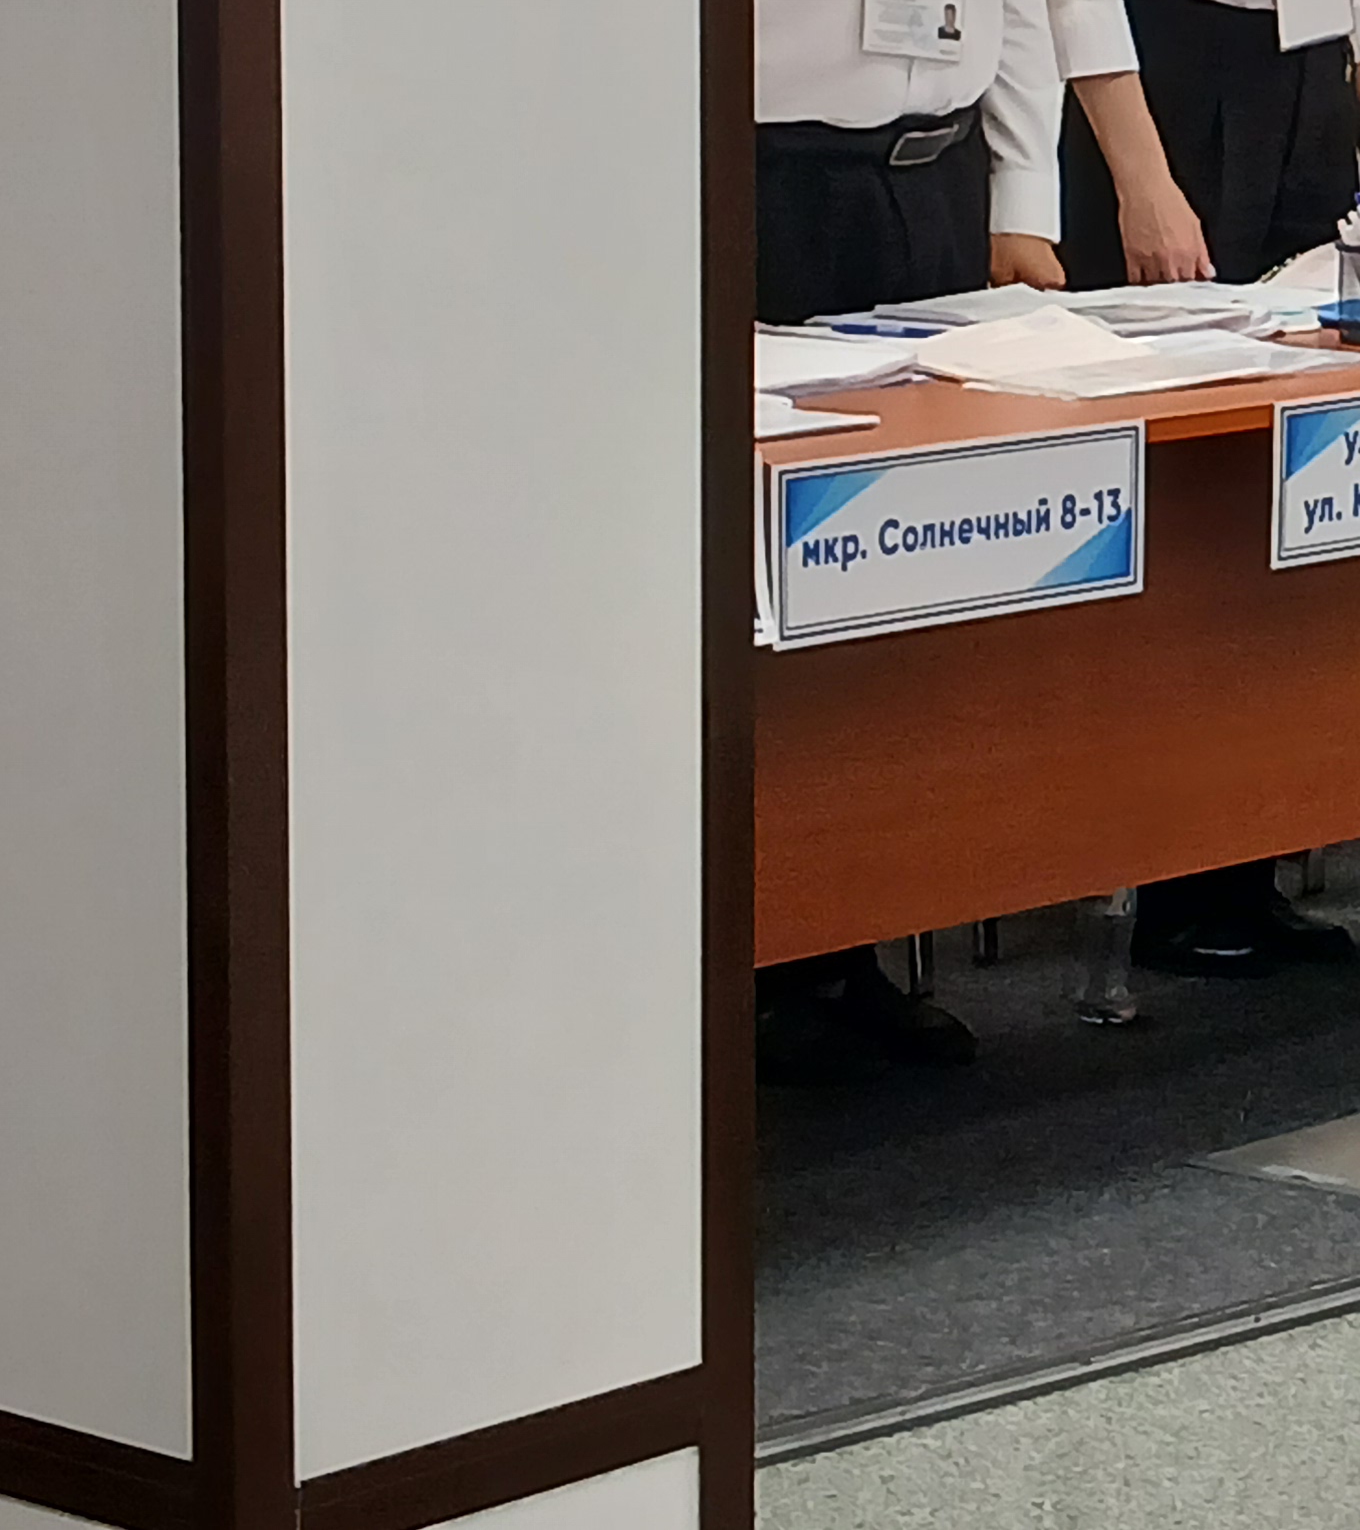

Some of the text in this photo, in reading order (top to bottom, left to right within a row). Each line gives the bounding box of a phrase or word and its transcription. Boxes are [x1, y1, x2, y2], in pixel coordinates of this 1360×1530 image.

[802, 488, 1122, 571] мкр. Солнечный 8-13
[1304, 496, 1342, 534] ул.
